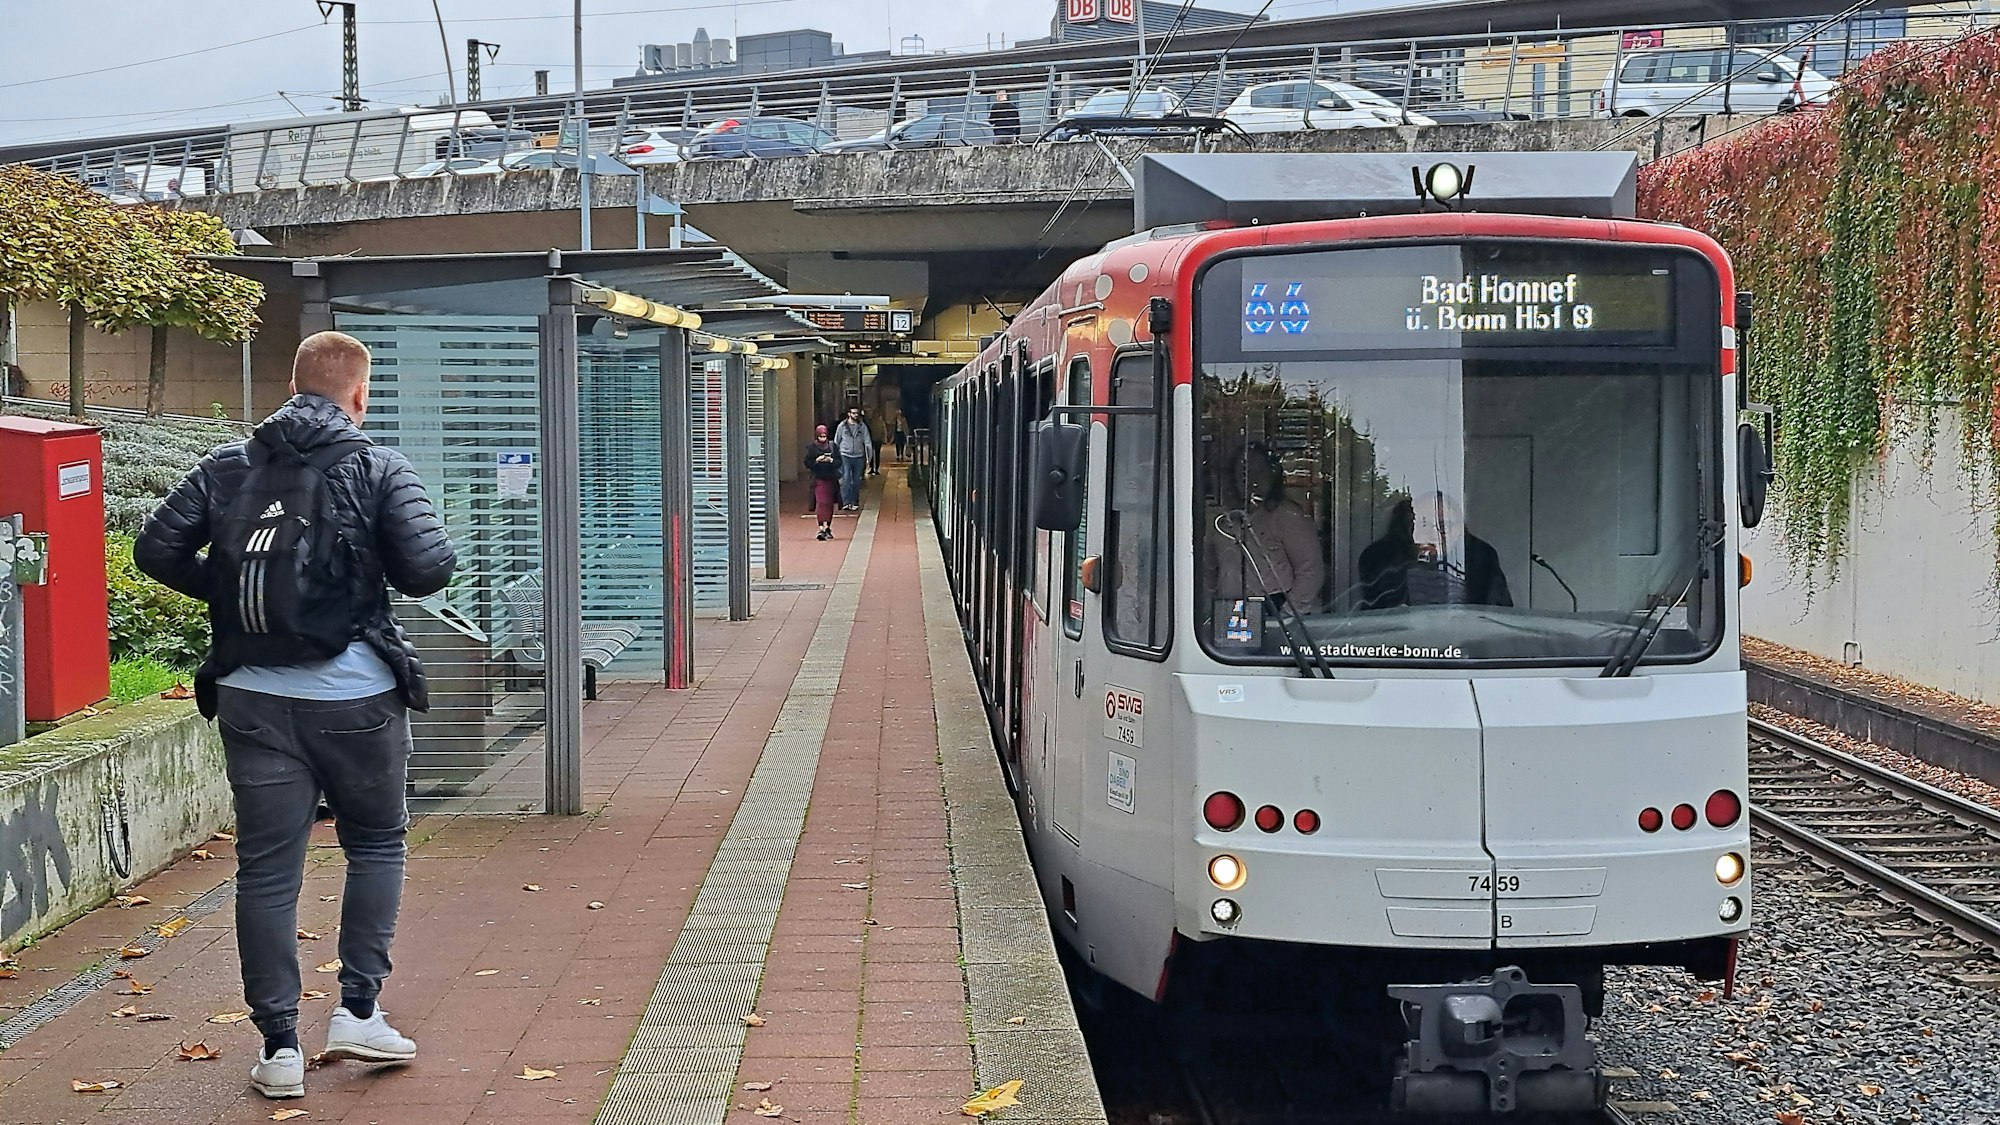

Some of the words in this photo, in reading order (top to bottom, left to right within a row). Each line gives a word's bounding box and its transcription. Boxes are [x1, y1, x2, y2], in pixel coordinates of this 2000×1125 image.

[1070, 0, 1094, 17] DB
[1111, 0, 1132, 17] DB
[1421, 274, 1473, 304] Bad
[1480, 274, 1577, 304] Honnef
[1245, 282, 1310, 334] 66
[896, 319, 908, 329] 12
[1406, 306, 1429, 331] ü.
[1438, 306, 1507, 331] Bonn
[1219, 688, 1237, 696] VRS
[1118, 725, 1134, 744] 7459
[1468, 875, 1520, 892] 7459
[1501, 915, 1513, 929] B
